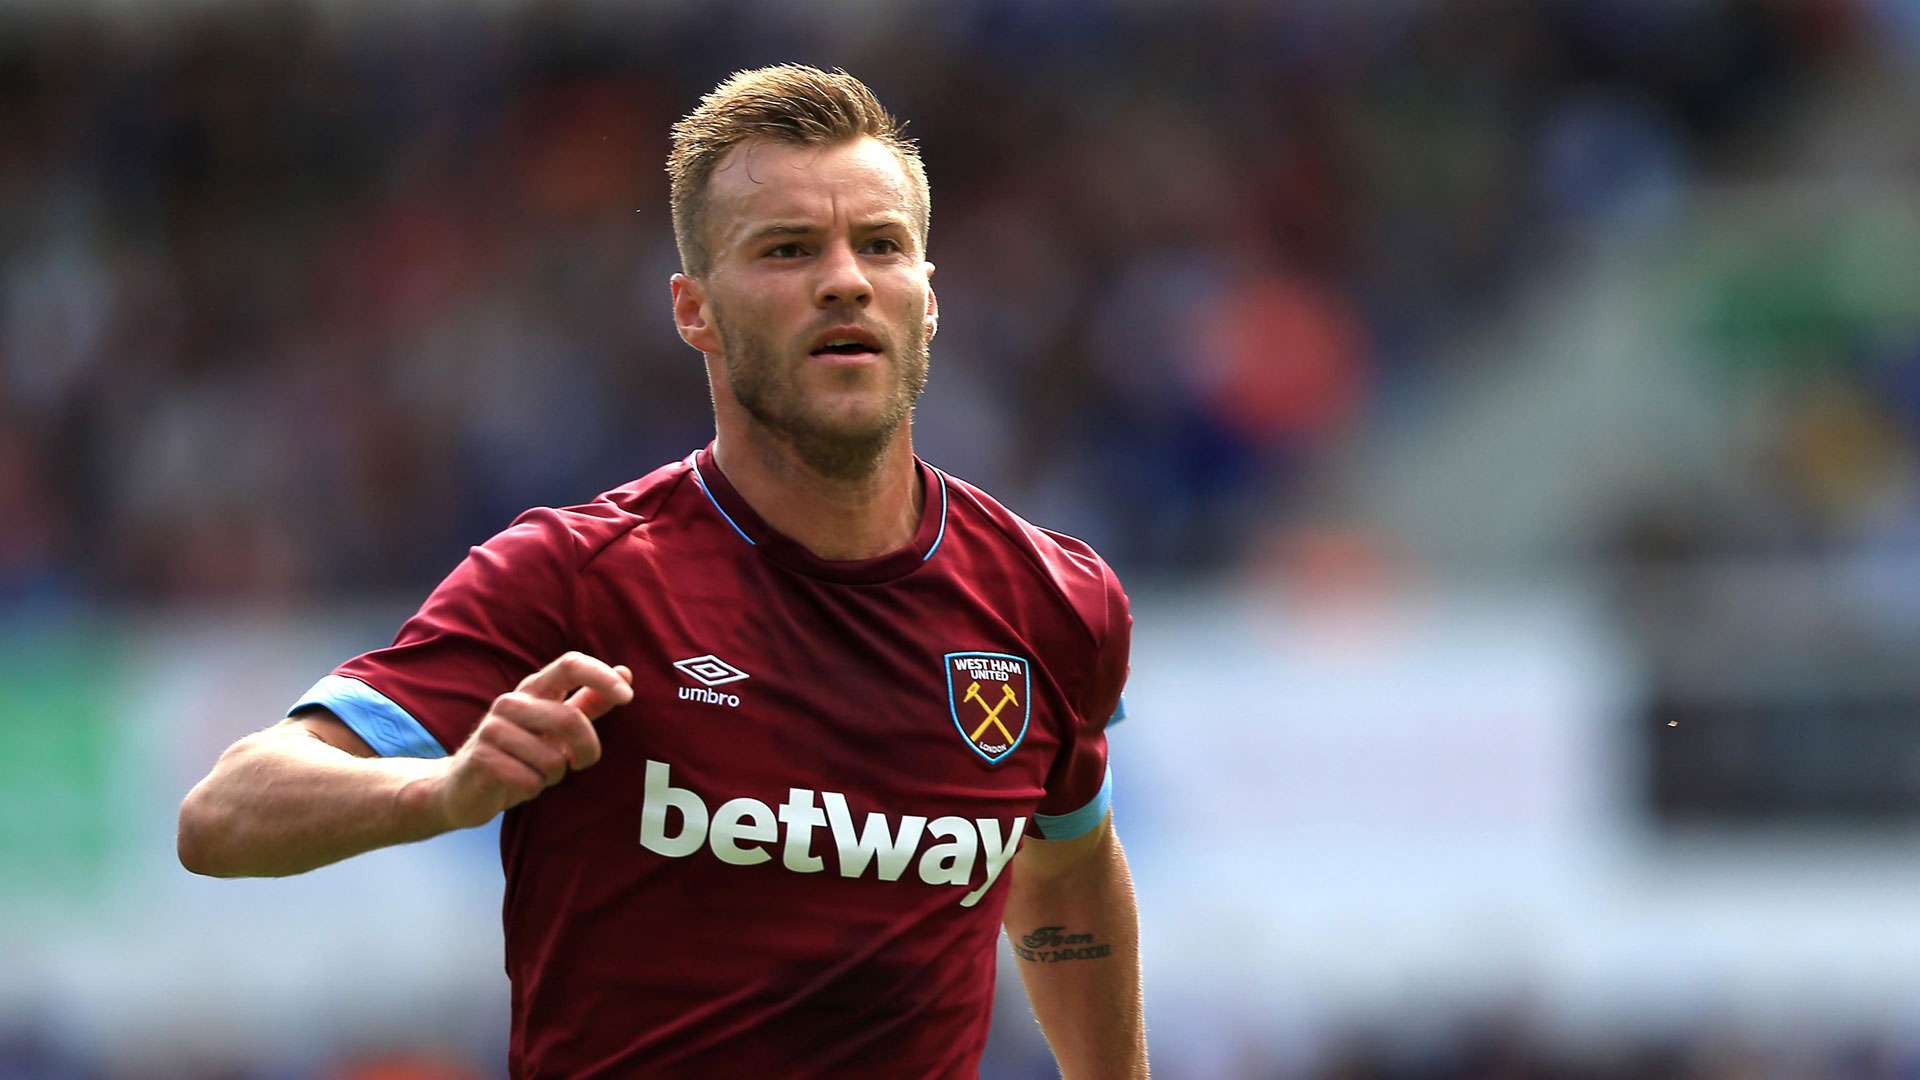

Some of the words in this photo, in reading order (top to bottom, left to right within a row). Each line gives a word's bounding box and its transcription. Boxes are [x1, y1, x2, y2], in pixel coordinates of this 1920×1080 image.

[954, 658, 989, 671] WEST
[990, 659, 1022, 675] HAM
[970, 669, 1009, 682] UNITED
[678, 686, 740, 708] umbro
[979, 741, 1008, 754] LONDON
[640, 759, 1028, 907] betway
